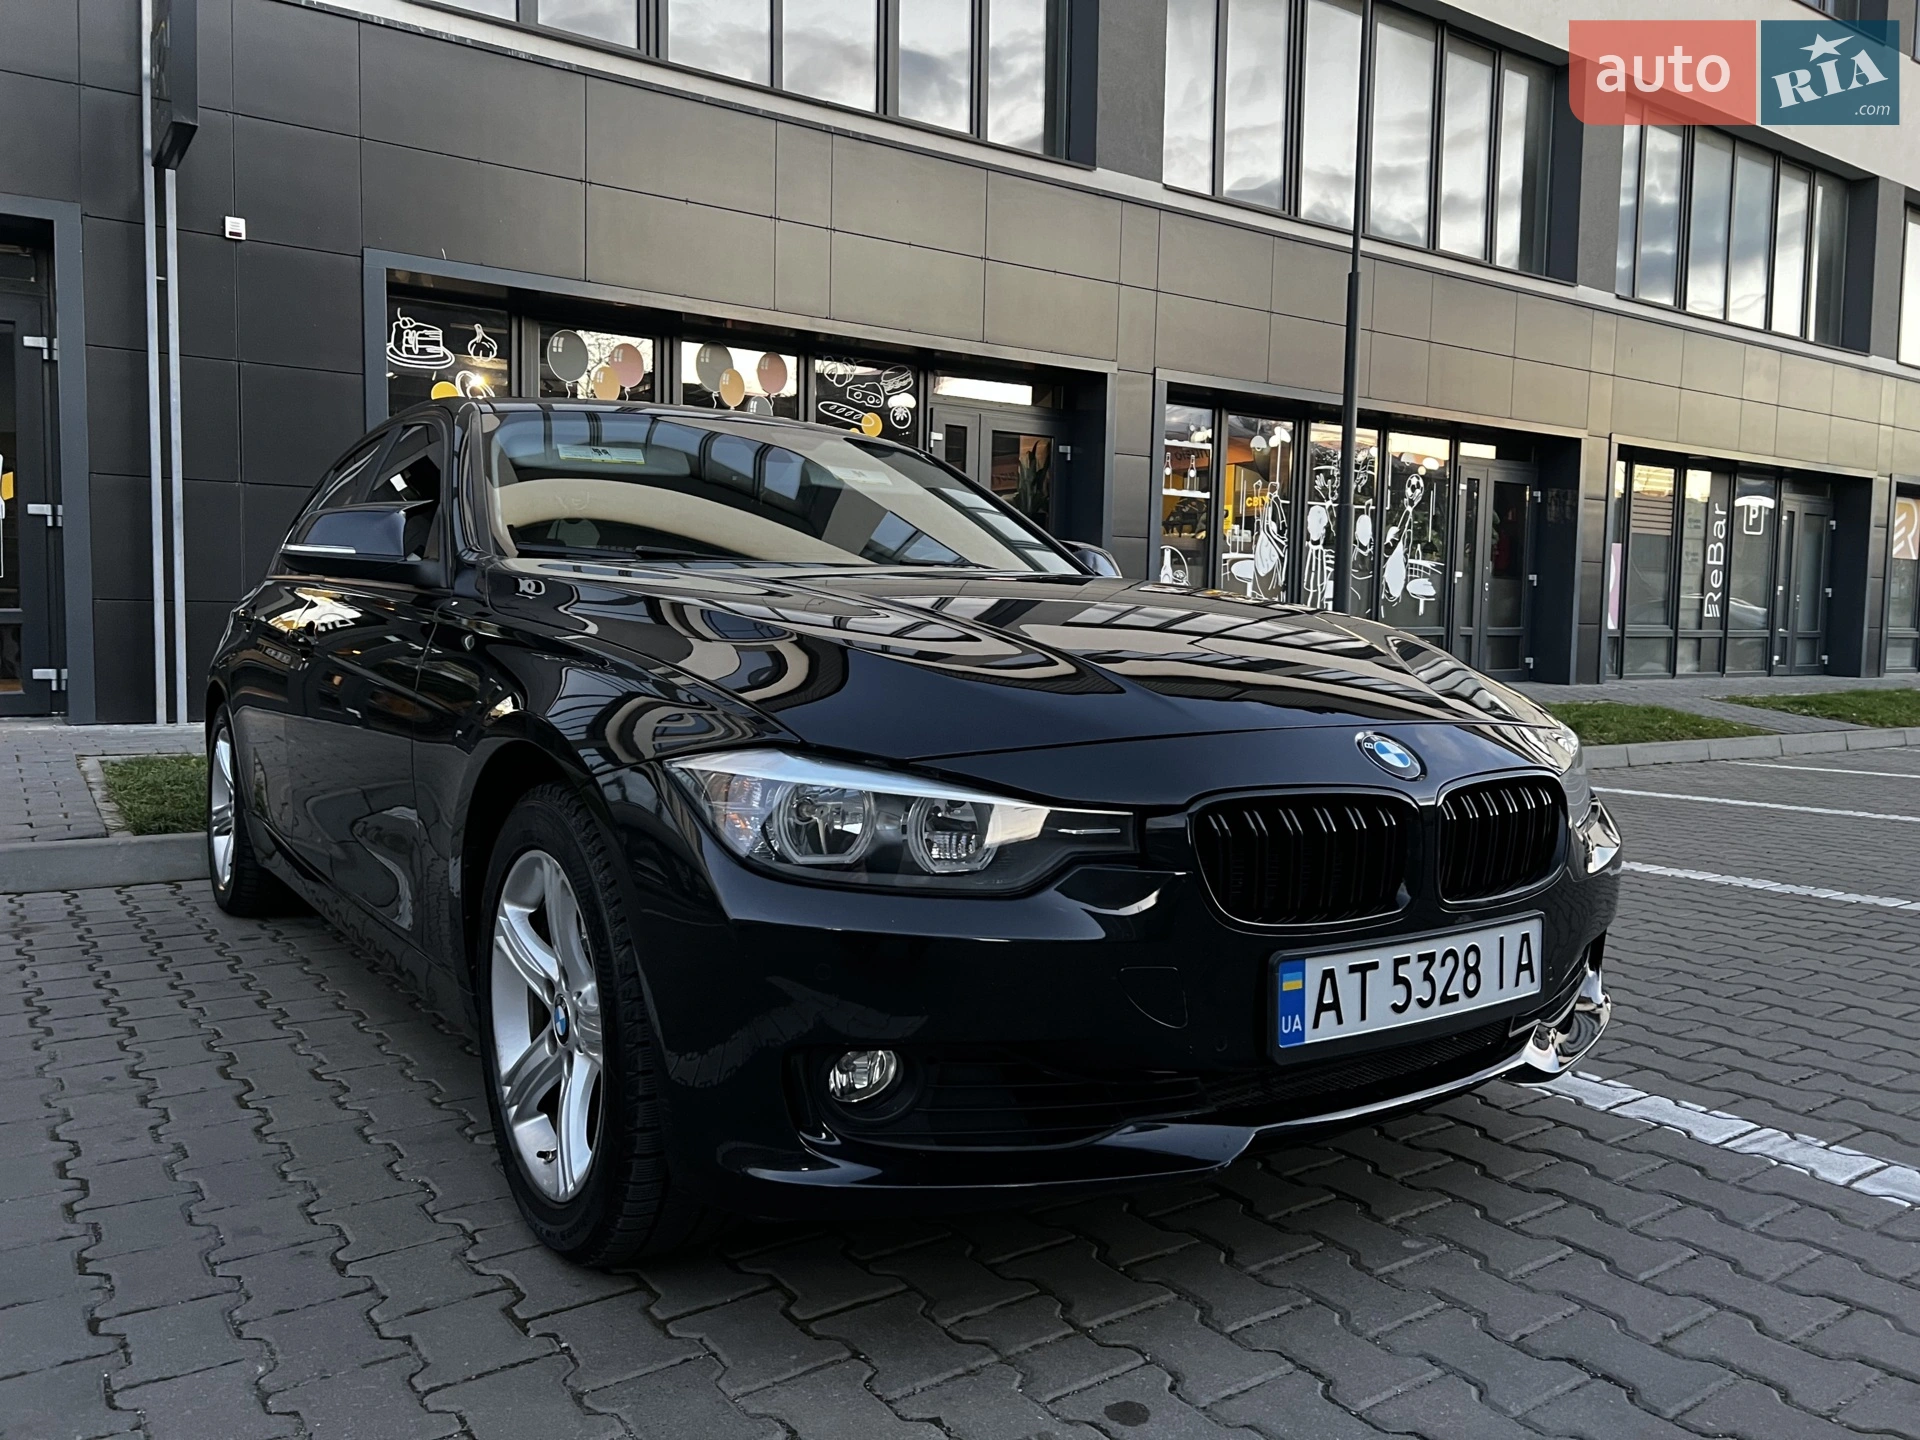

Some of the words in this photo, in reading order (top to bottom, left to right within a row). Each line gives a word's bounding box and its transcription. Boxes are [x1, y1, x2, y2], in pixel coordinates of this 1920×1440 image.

[1704, 503, 1727, 618] ReBar
[1281, 1014, 1302, 1034] UA
[1311, 959, 1380, 1030] AT
[1390, 942, 1482, 1014] 5328
[1498, 931, 1536, 991] IA
